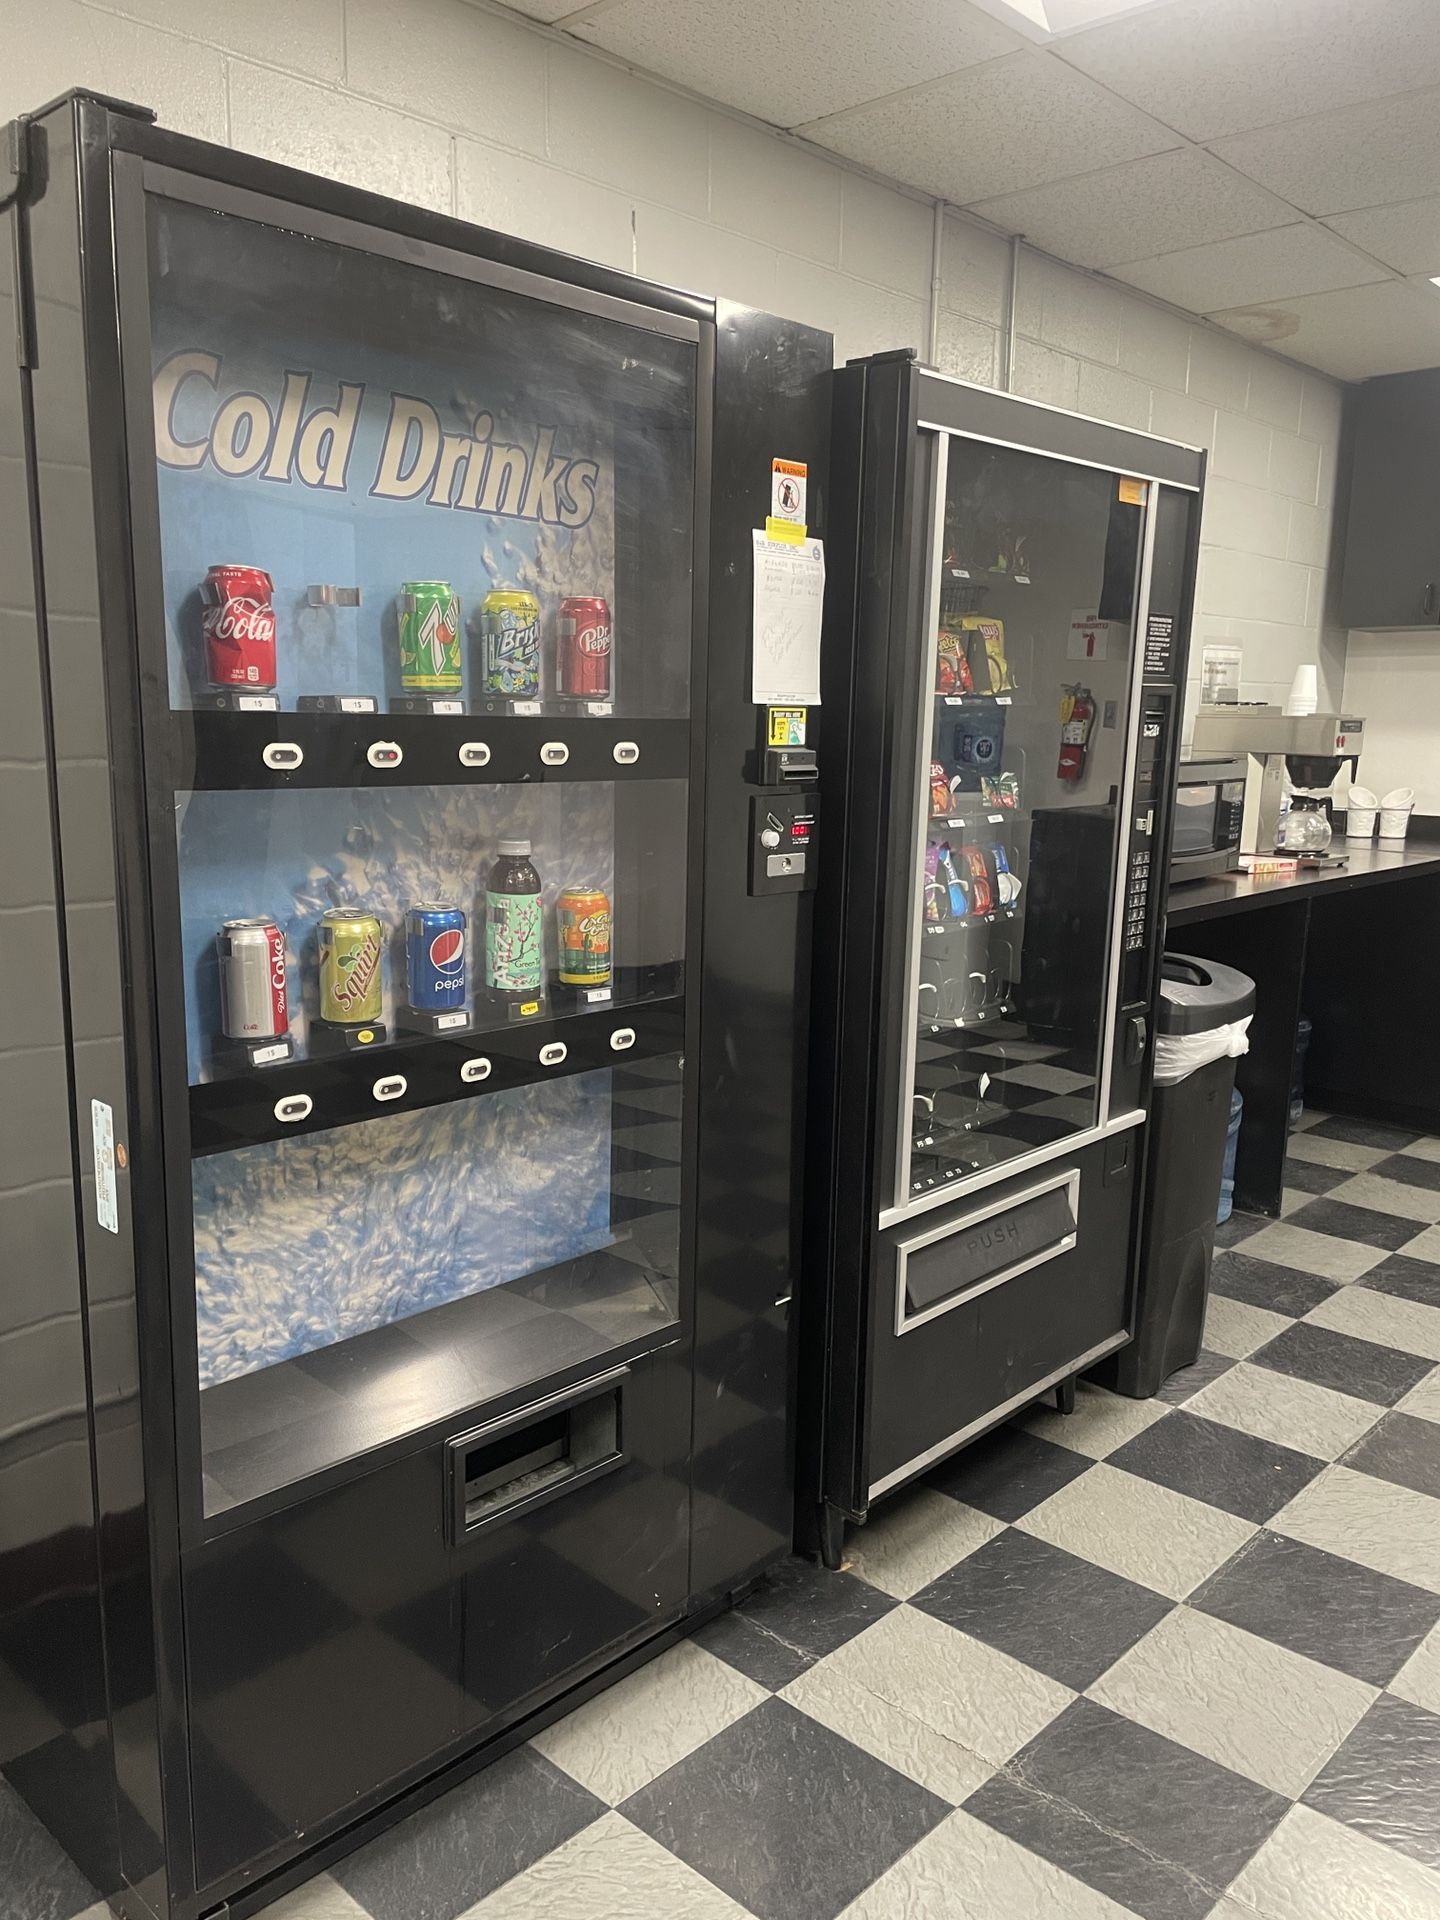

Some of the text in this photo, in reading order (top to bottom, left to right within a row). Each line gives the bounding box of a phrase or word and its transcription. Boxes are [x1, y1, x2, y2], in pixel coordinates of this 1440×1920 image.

[154, 348, 600, 530] Cold Drinks
[596, 625, 609, 639] Dr
[271, 937, 285, 990] Coke
[333, 933, 378, 1012] Squirt
[514, 960, 534, 969] Green
[967, 1221, 1019, 1257] PUSH
